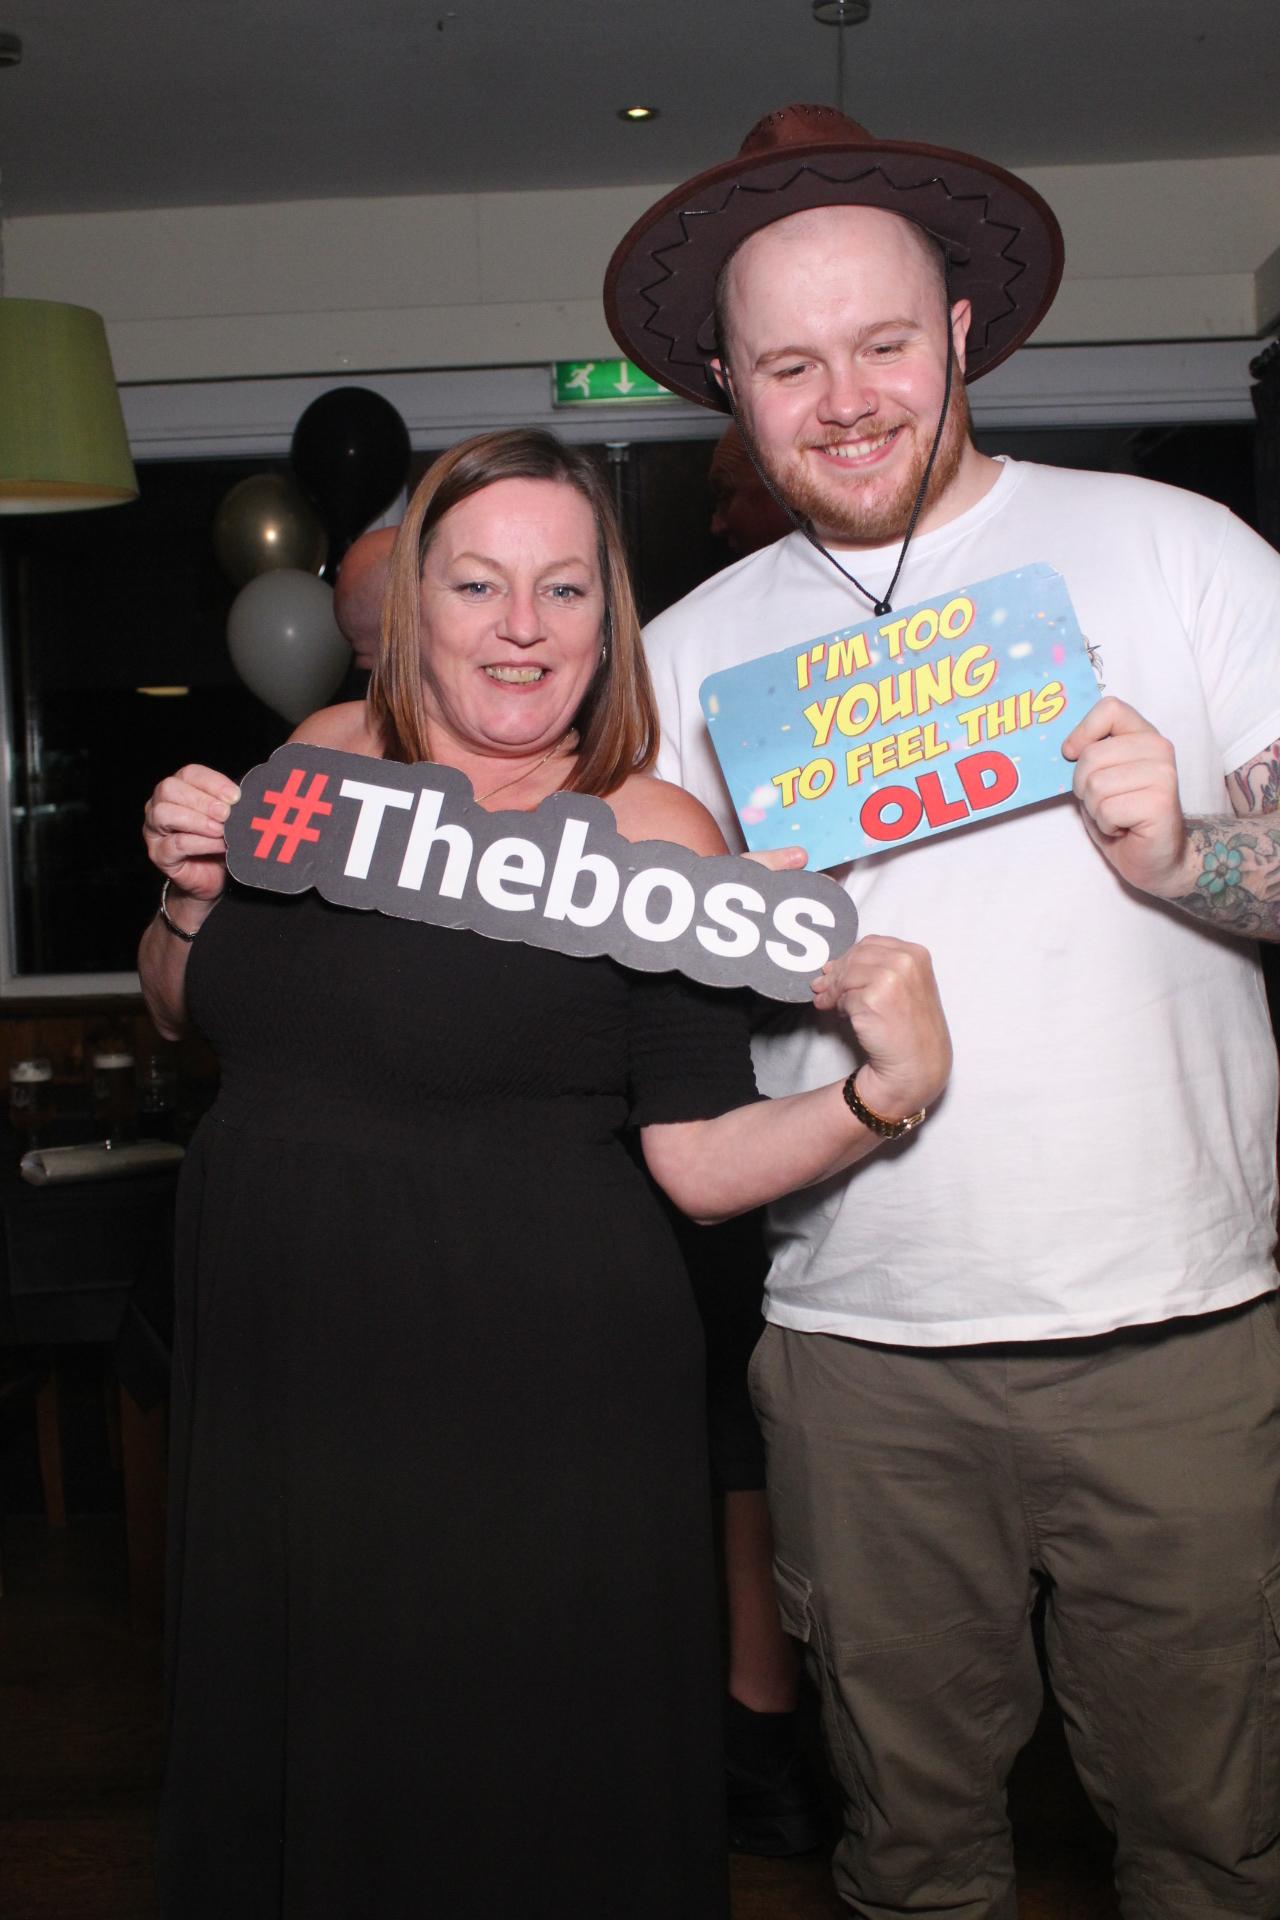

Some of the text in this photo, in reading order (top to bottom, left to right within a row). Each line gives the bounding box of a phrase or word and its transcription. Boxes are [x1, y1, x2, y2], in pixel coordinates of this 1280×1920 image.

[796, 597, 976, 691] I'M TOO
[803, 644, 998, 747] YOUNG
[771, 681, 1067, 808] TO FEEL THIS
[859, 750, 1019, 842] OLD
[250, 769, 836, 973] #Theboss
